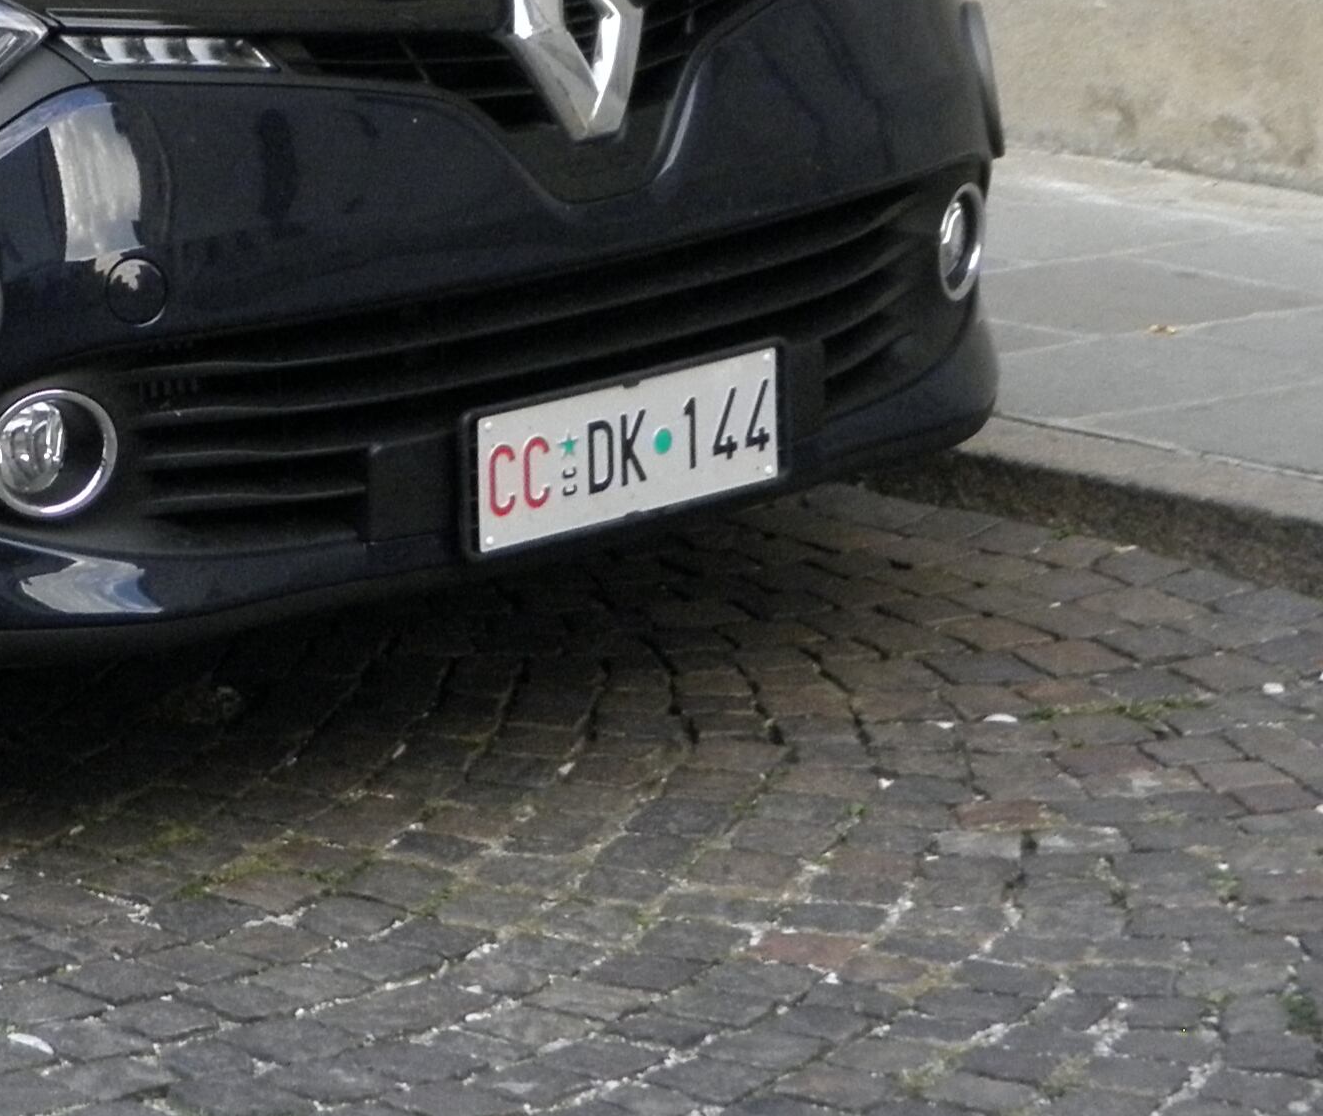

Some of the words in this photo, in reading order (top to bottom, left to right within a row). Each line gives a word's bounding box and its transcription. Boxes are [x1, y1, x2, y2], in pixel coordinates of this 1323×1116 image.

[488, 434, 551, 518] CC
[586, 408, 648, 496] DK
[683, 377, 771, 470] 144
